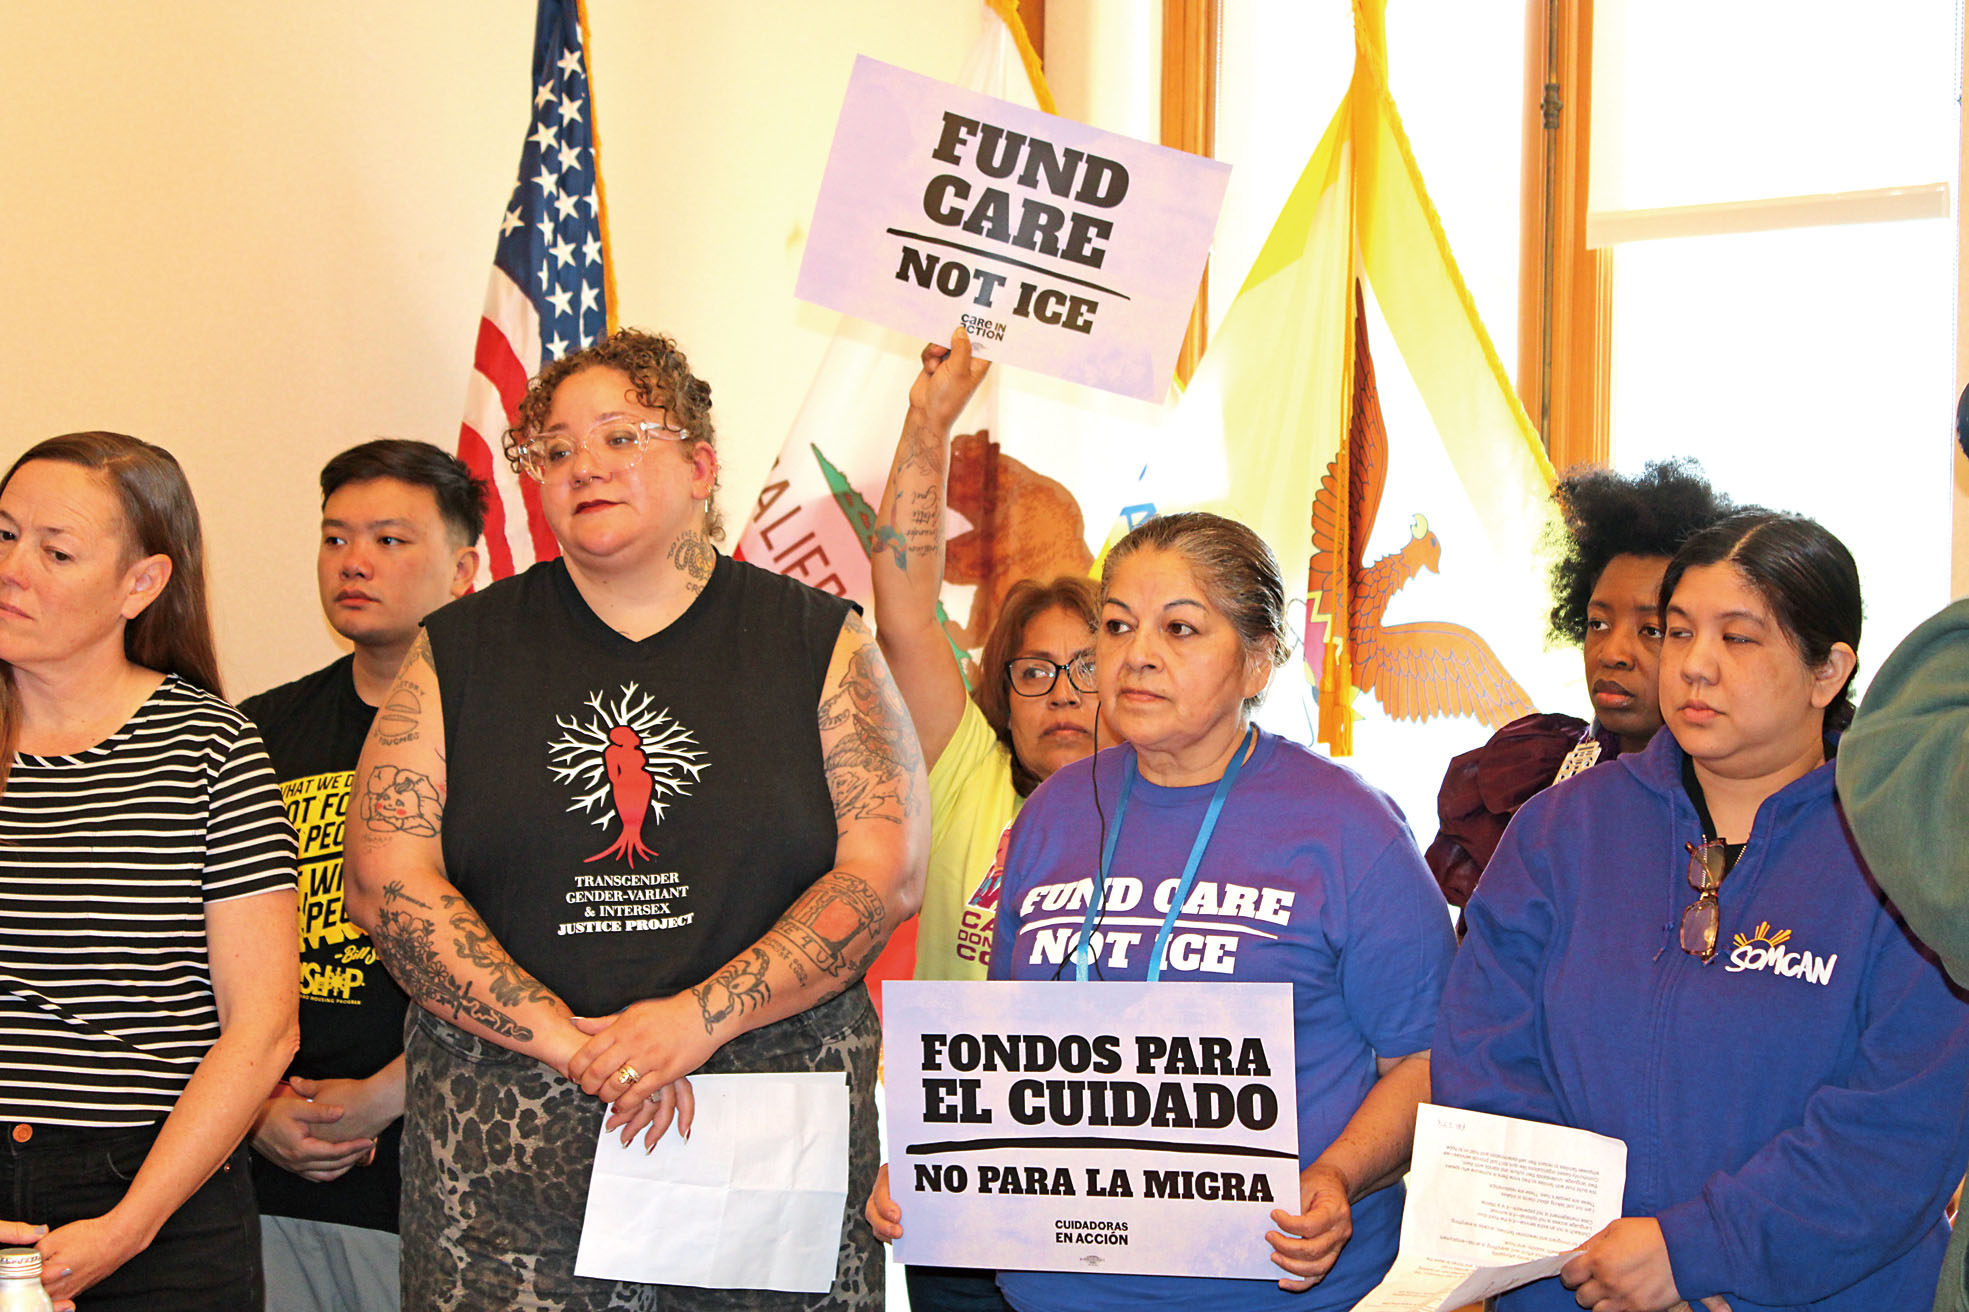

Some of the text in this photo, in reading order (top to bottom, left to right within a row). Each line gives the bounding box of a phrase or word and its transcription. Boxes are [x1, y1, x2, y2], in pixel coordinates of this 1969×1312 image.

[931, 110, 1130, 209] FUND
[922, 173, 1114, 270] CARE
[894, 245, 1099, 335] NOT ICE
[994, 322, 1007, 333] IN
[753, 456, 847, 598] ALIF
[317, 775, 342, 791] WE
[565, 886, 689, 903] GENDER-VARIANT
[574, 872, 680, 888] TRANSGENDER
[584, 903, 671, 918] & INTERSEX
[1020, 876, 1295, 926] FUND CARE
[557, 912, 694, 936] JUSTICE PROJECT
[1029, 928, 1142, 969] NOT
[1724, 945, 1838, 985] SOMCAN
[921, 1033, 1271, 1076] FONDOS PARA
[922, 1078, 1278, 1131] EL CUIDADO
[914, 1164, 1274, 1203] NO PARA LA MIGRA
[1055, 1219, 1129, 1232] CUIDADORAS
[1055, 1230, 1129, 1246] EN ACCIÓN
